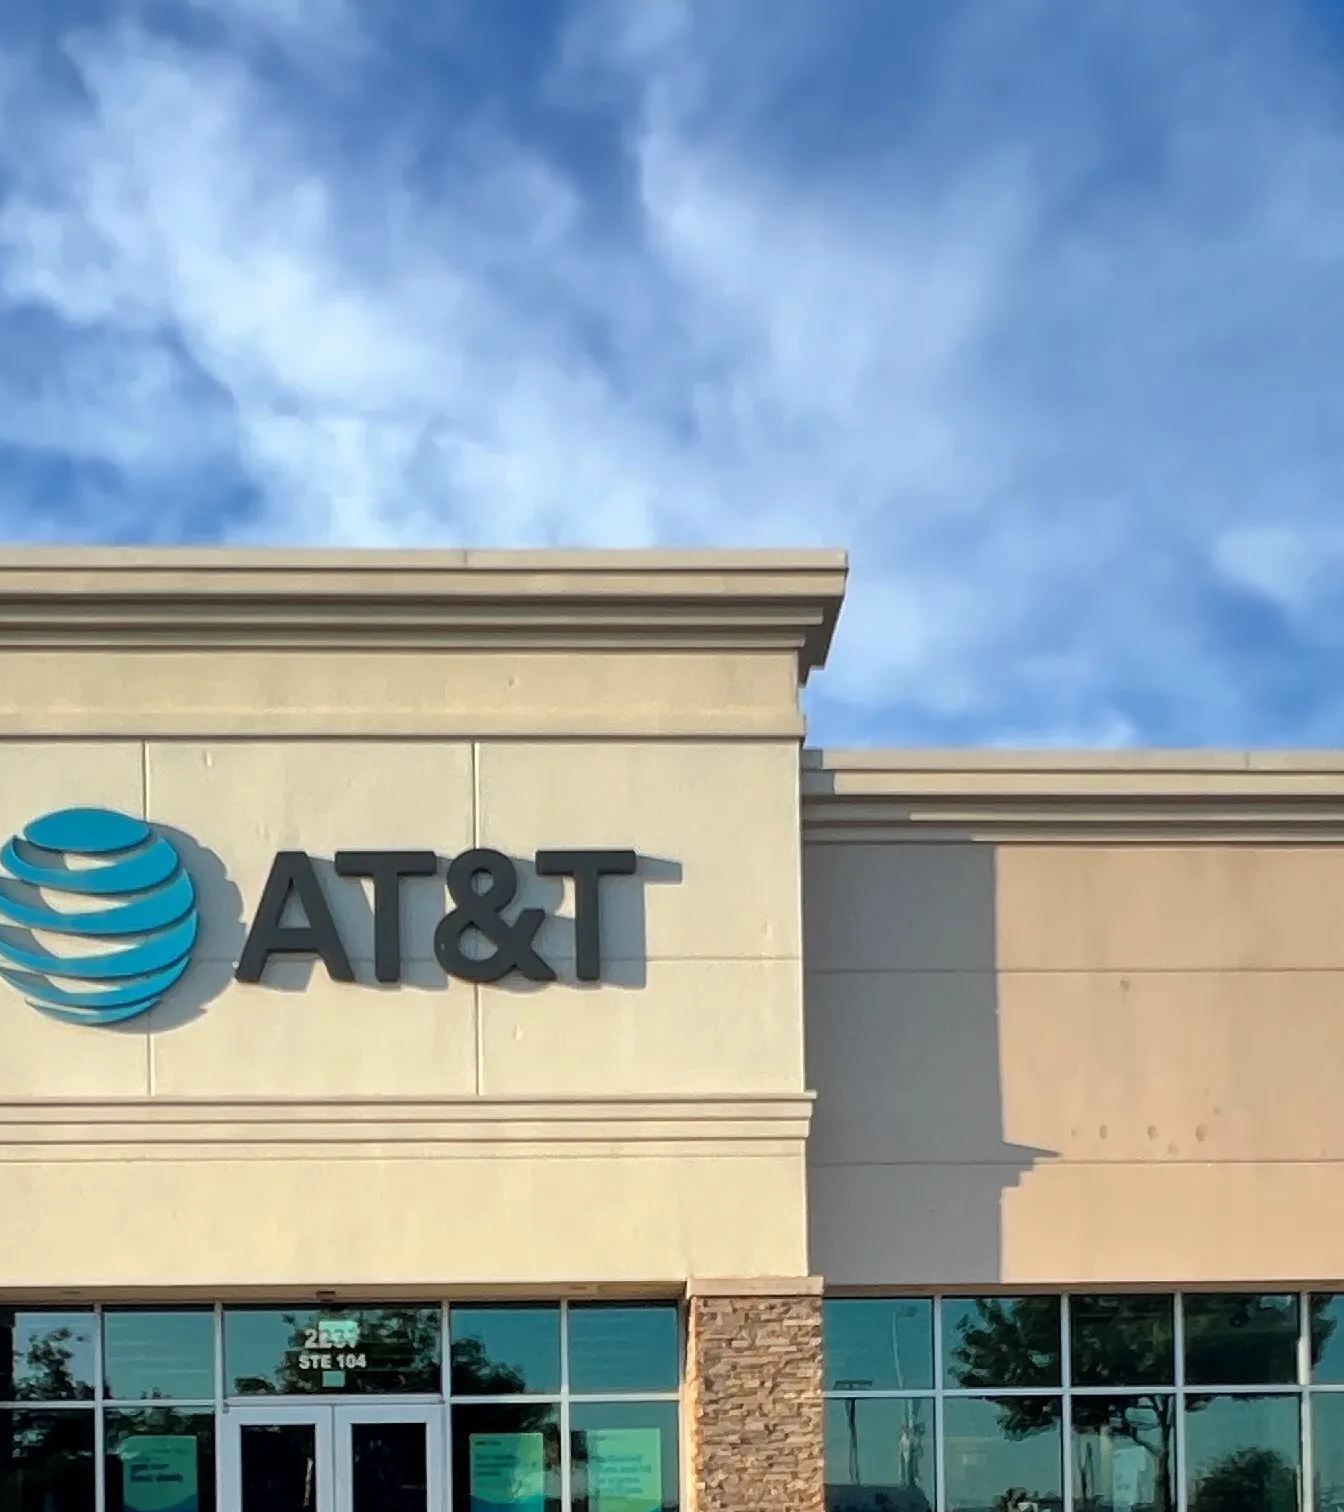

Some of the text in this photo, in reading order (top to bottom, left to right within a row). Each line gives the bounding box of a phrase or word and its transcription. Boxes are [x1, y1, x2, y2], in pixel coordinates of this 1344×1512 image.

[234, 848, 636, 984] AT&T
[298, 1352, 367, 1370] STE 104
